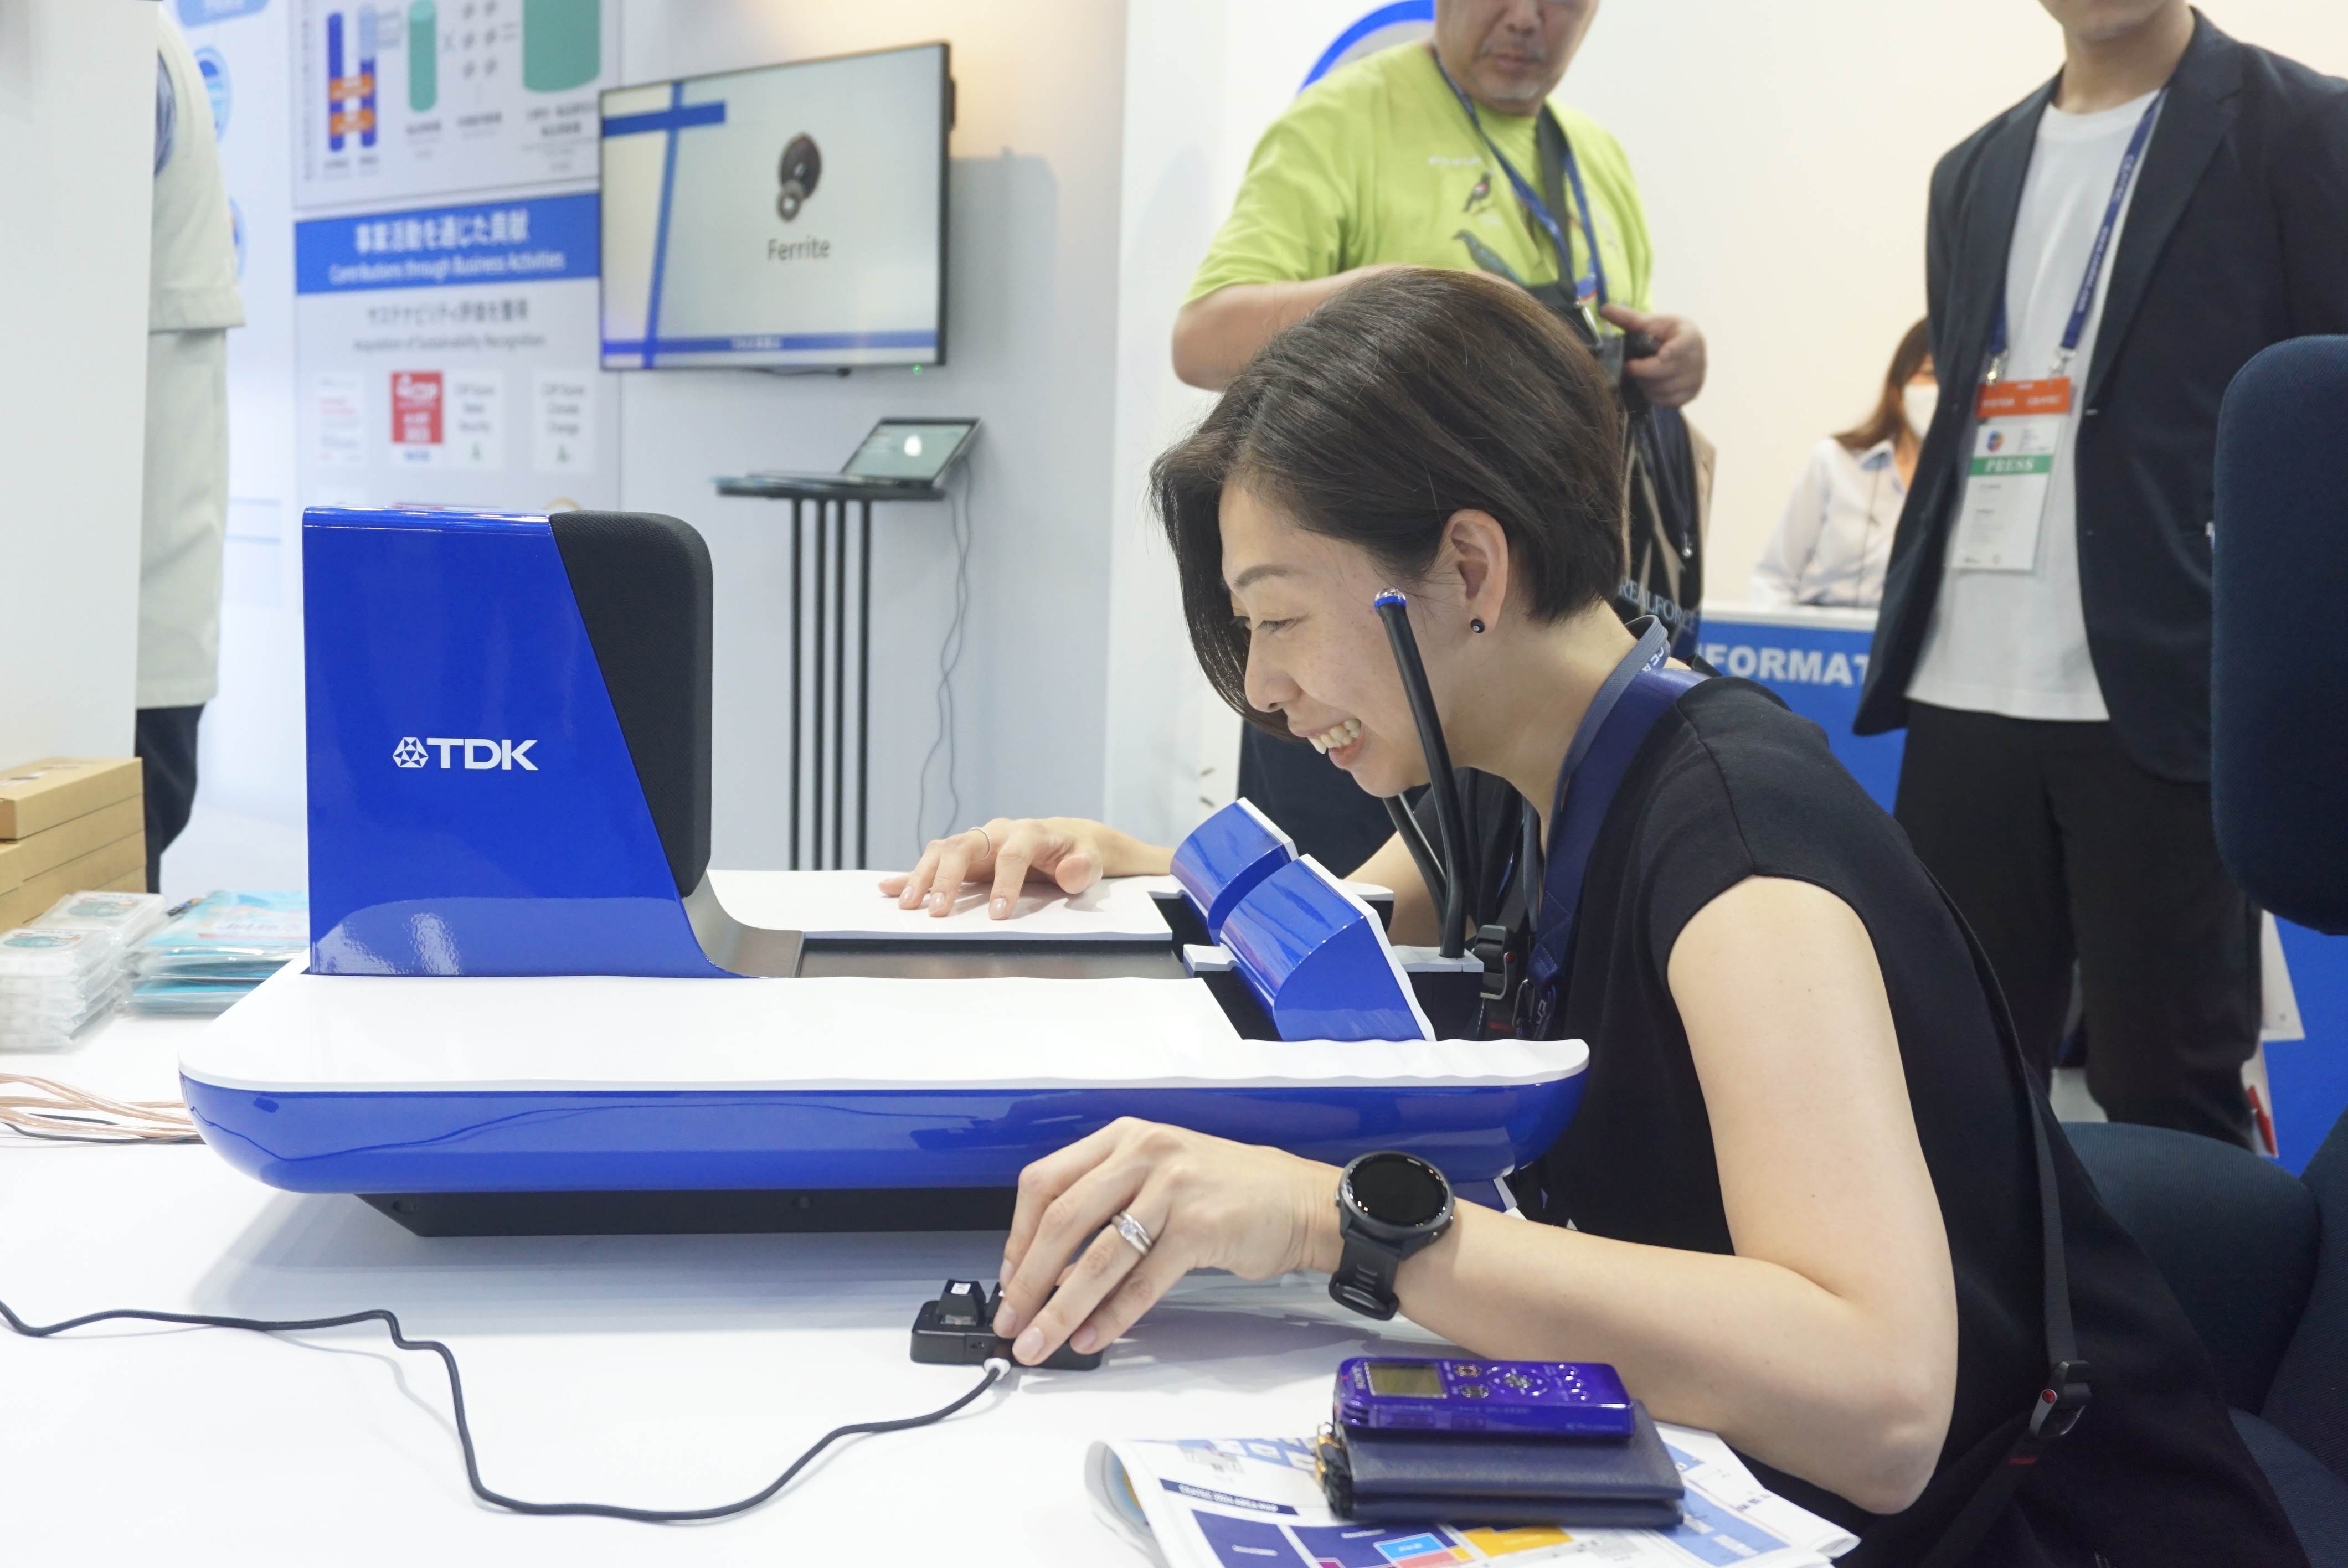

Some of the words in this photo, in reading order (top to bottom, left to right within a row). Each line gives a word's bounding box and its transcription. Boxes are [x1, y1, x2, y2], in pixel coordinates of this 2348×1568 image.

[767, 235, 831, 261] Ferrite
[329, 261, 402, 285] Contributions
[405, 256, 450, 283] through
[452, 254, 506, 276] Business
[507, 250, 567, 272] Activities
[1985, 458, 2035, 472] PRESS
[1696, 642, 1870, 688] FORMAT
[426, 737, 539, 771] TDK
